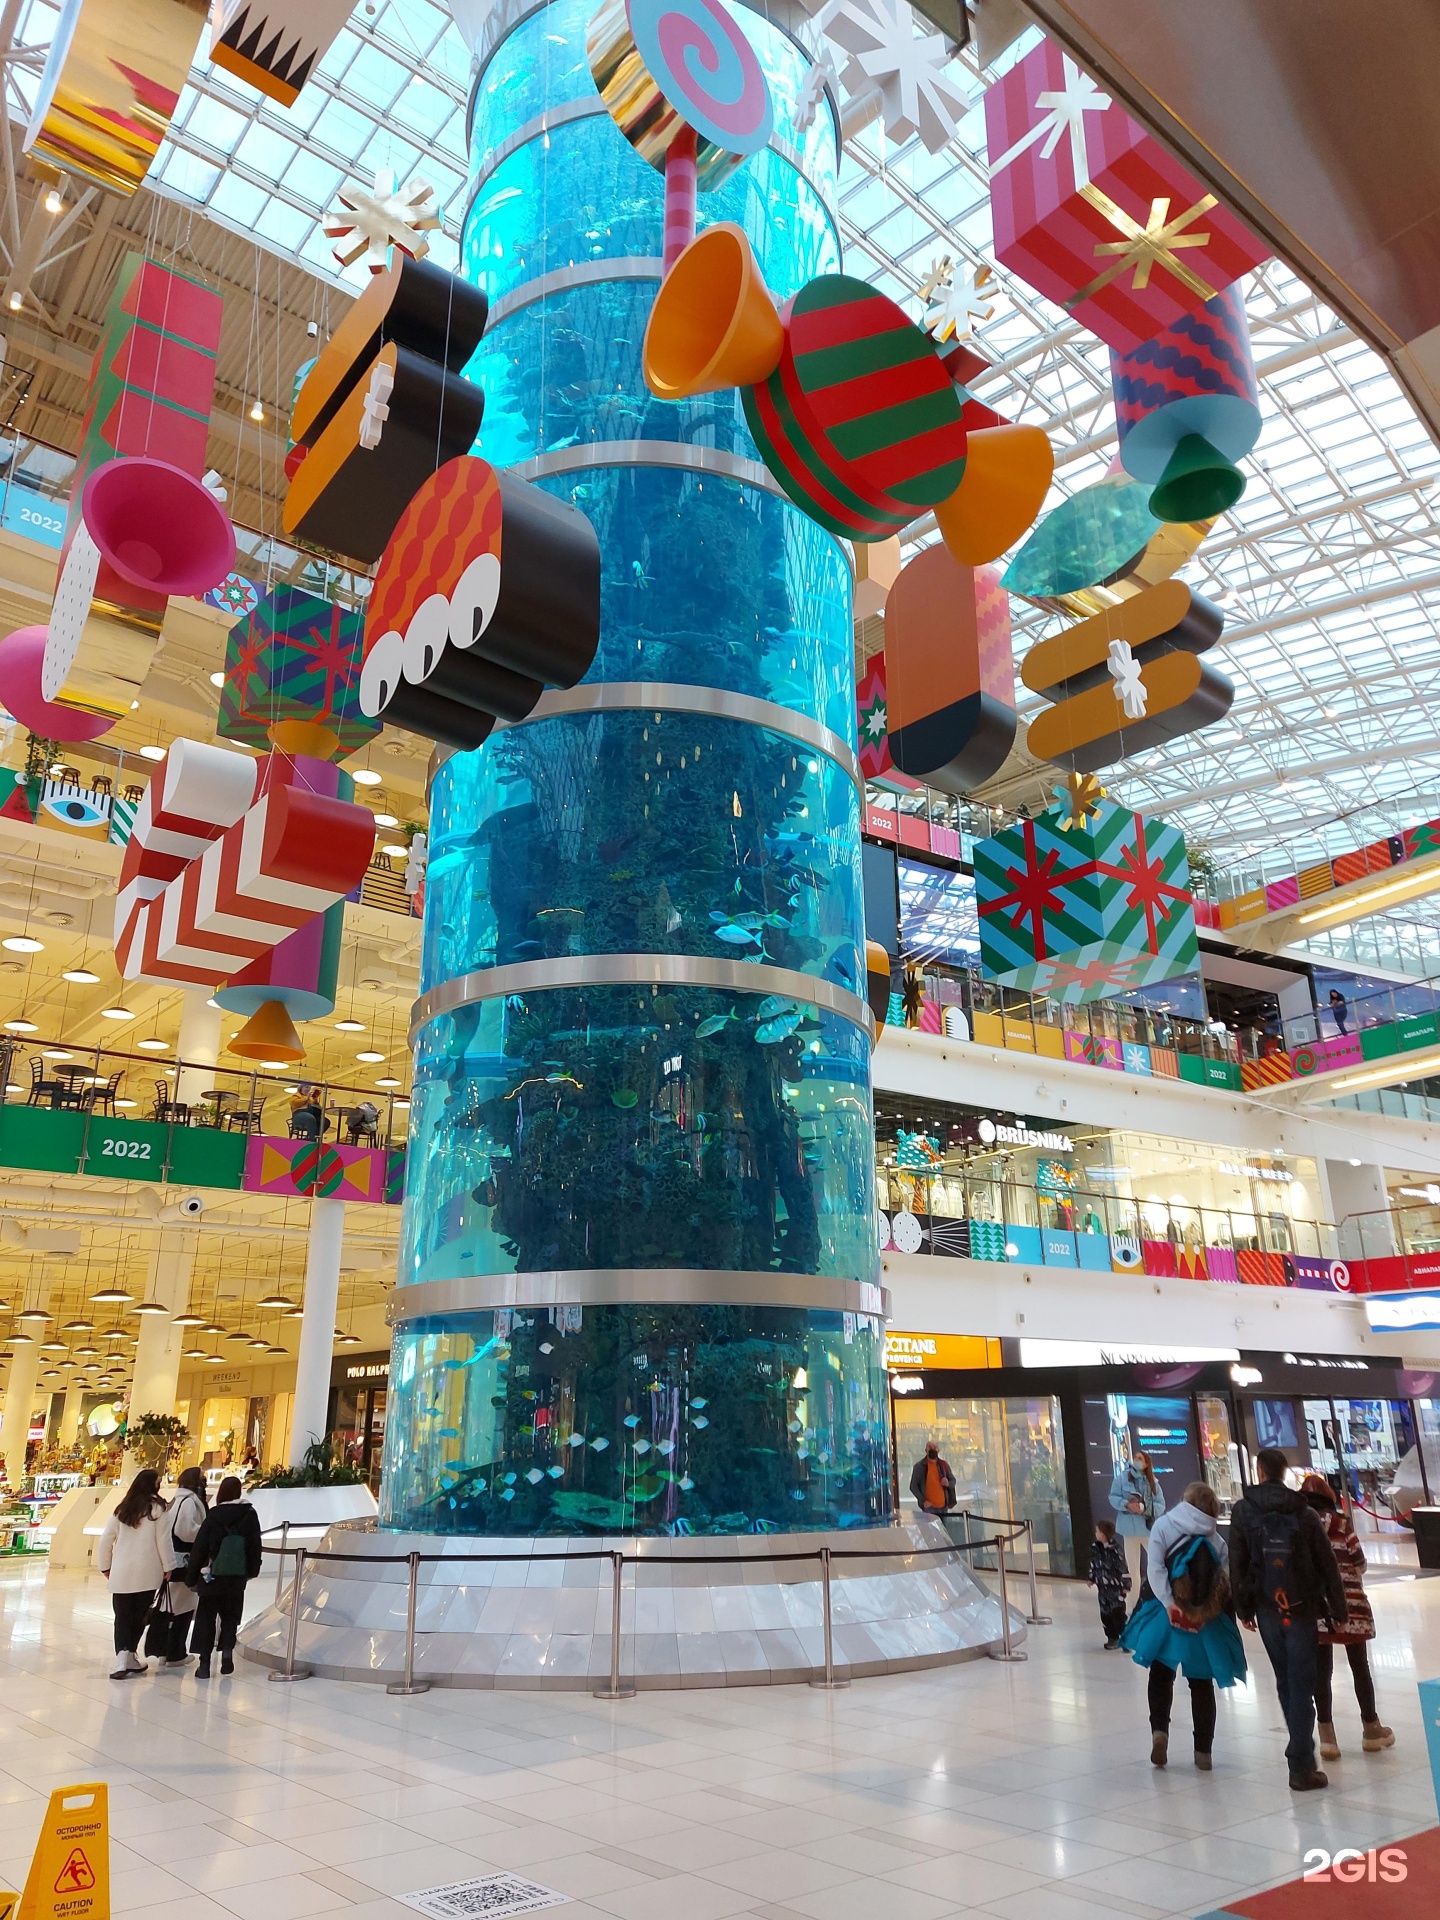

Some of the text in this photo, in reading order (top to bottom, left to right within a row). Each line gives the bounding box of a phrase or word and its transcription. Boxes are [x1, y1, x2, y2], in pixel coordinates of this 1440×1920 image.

[20, 508, 62, 533] 2022
[872, 816, 892, 830] 2022
[1403, 1027, 1434, 1038] АВИАПАРК
[1210, 1069, 1227, 1080] 2022
[102, 1139, 151, 1159] 2022
[1049, 1242, 1070, 1255] 2022
[212, 1371, 241, 1382] WEEKEND
[347, 1364, 389, 1378] POLO RALPH
[56, 1823, 101, 1835] ОСТОРОЖНО
[419, 1873, 509, 1897] НАЙДИ МАГАЗИН
[53, 1898, 93, 1912] CAUTION
[71, 1908, 89, 1916] FLOOR
